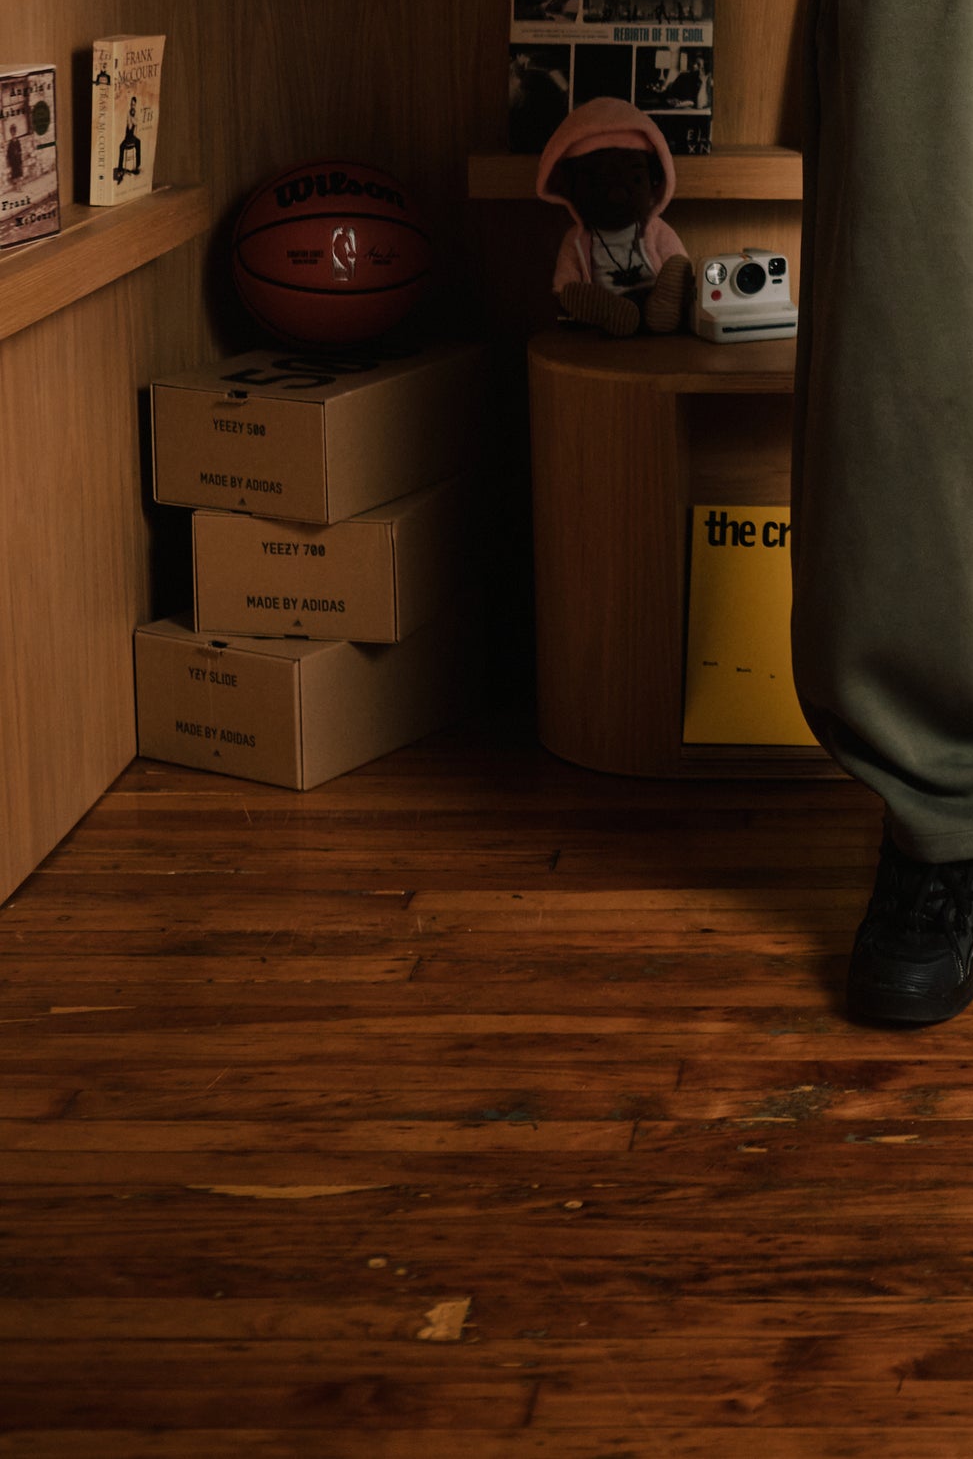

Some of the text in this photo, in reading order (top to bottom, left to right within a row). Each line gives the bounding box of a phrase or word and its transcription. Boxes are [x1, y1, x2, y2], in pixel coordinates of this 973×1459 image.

[613, 27, 649, 42] REBIRTH
[652, 28, 662, 42] OF
[665, 28, 680, 42] THE
[683, 28, 703, 42] COOL
[125, 48, 153, 65] FRANK
[275, 172, 405, 209] Wilson
[2, 195, 31, 211] Frank
[15, 210, 56, 227] McCourt
[212, 419, 266, 437] YEEZY 500
[200, 472, 282, 494] MADE BY ADIDAS
[705, 511, 756, 546] the
[261, 542, 326, 556] YEEZY 700
[247, 596, 345, 612] MADE BY ADIDAS
[188, 666, 238, 687] YZY SLIDE
[176, 721, 256, 747] MADE BY ADIDAS
